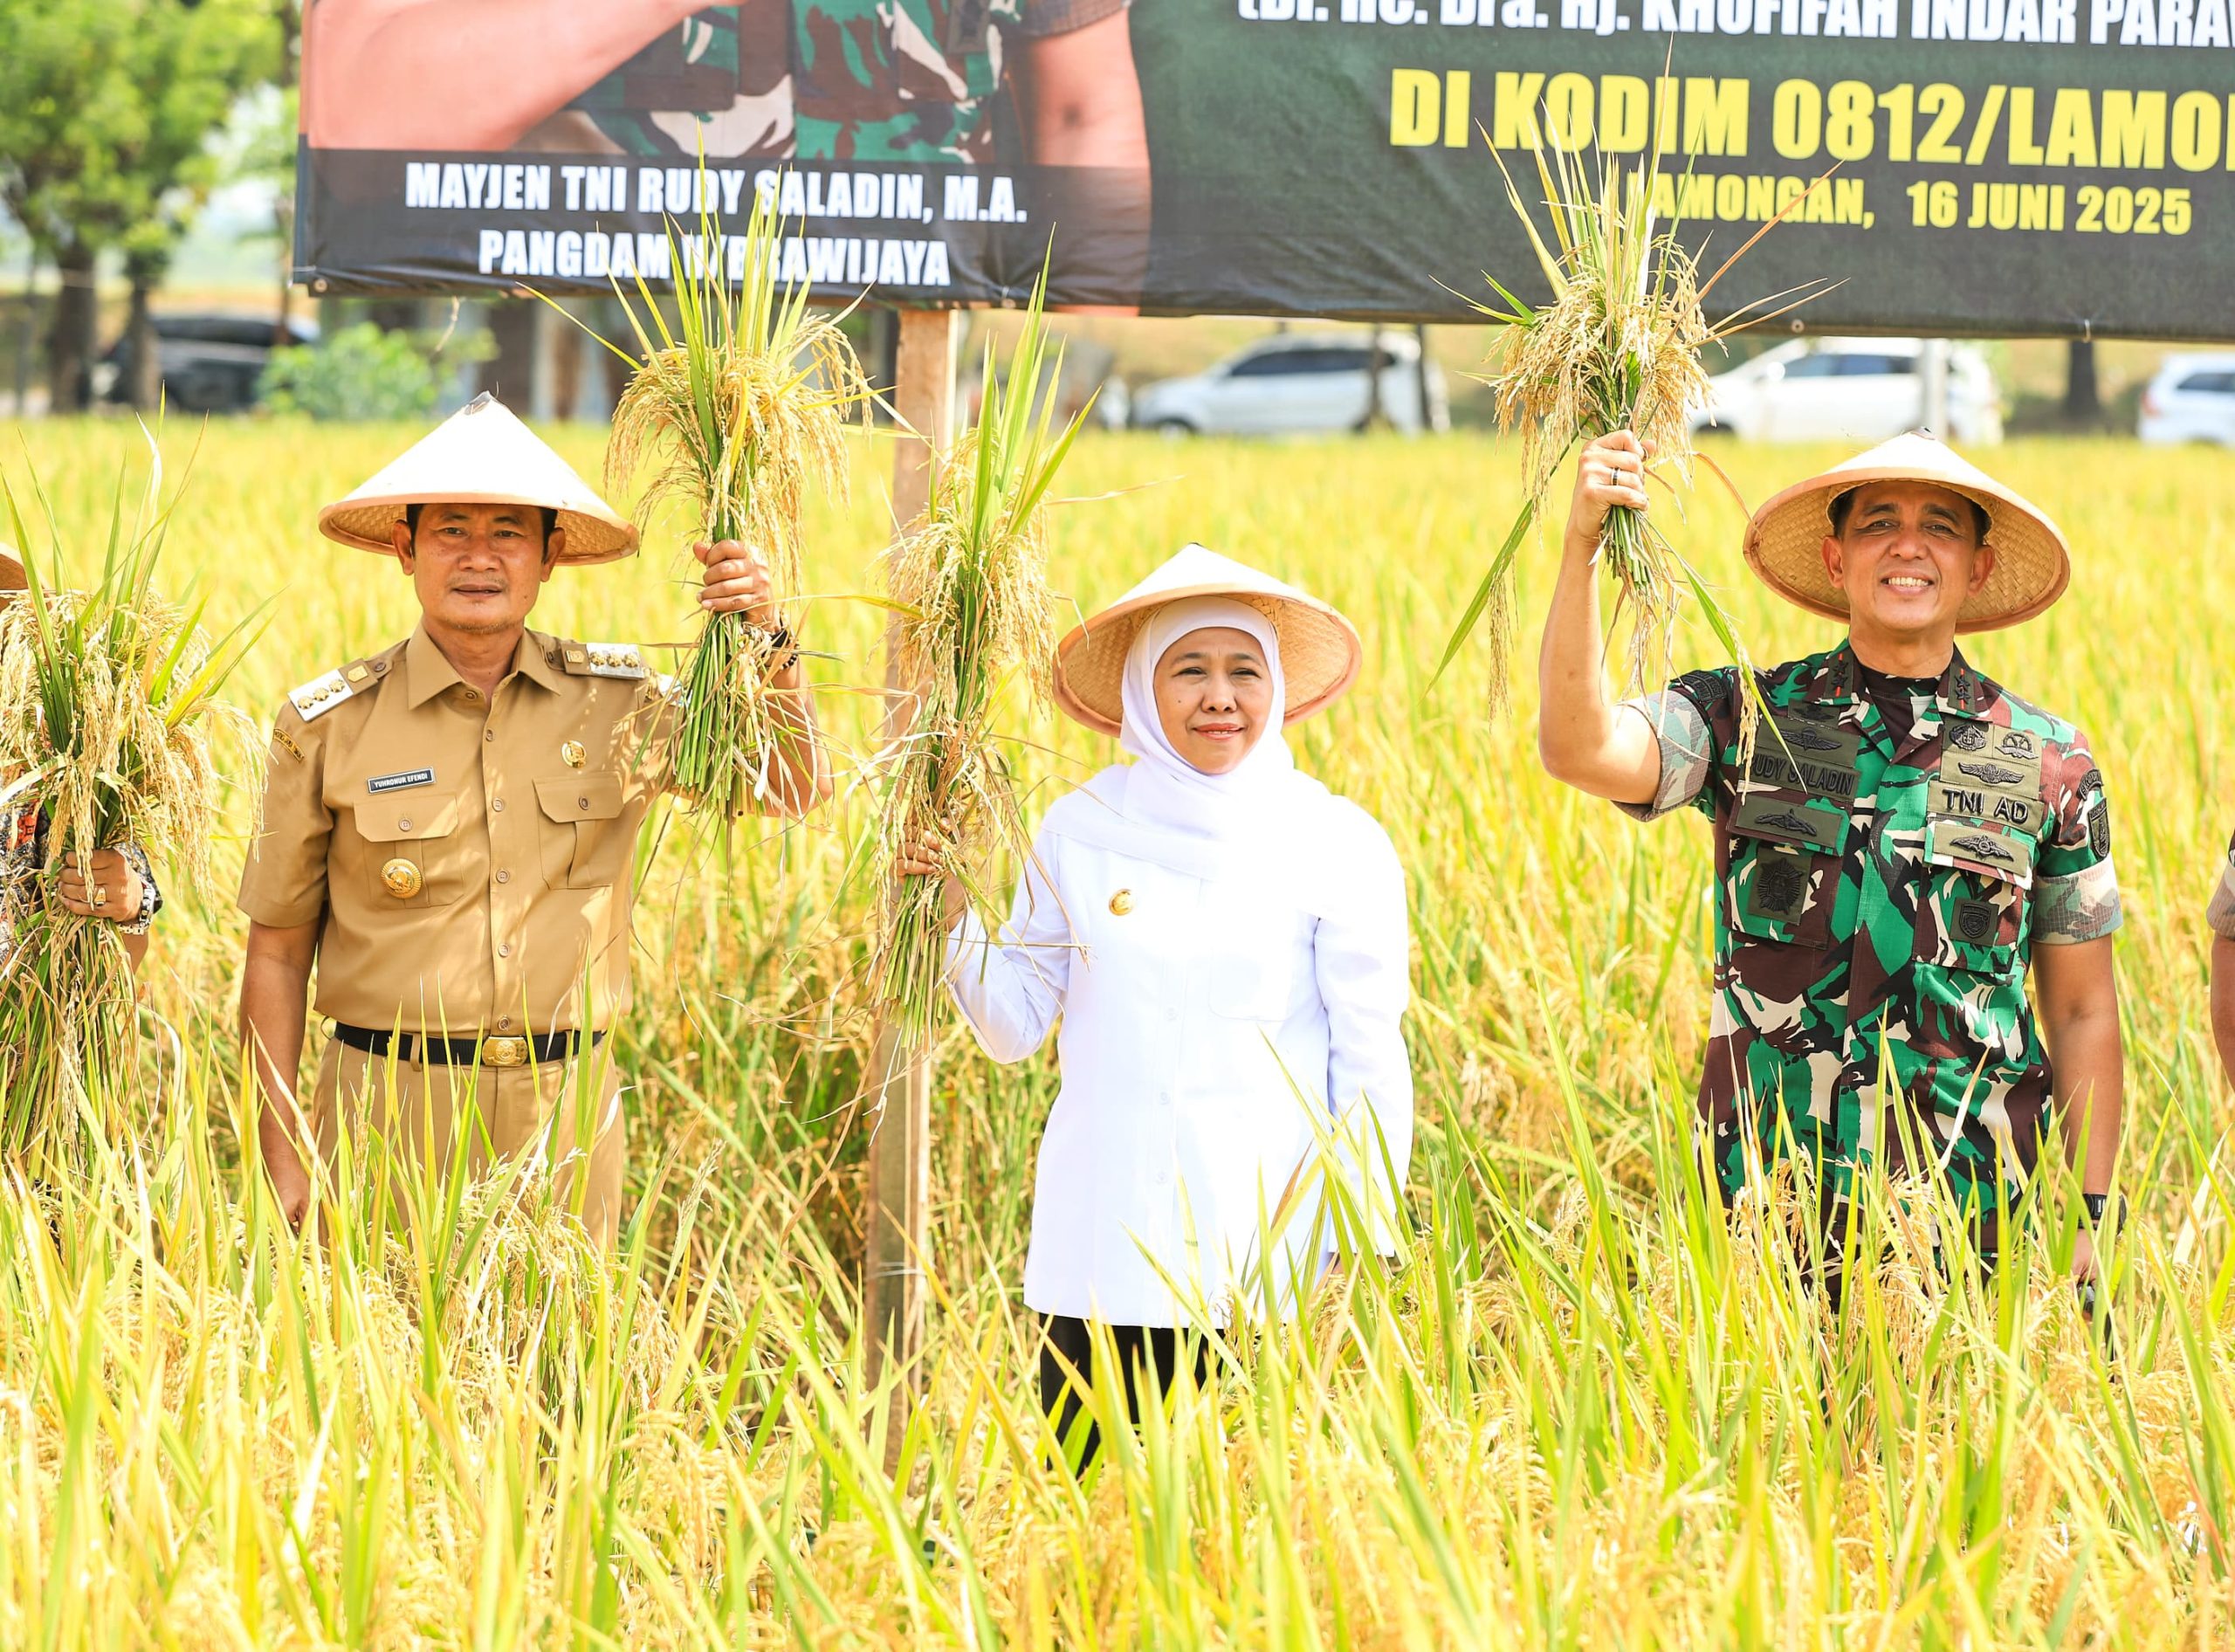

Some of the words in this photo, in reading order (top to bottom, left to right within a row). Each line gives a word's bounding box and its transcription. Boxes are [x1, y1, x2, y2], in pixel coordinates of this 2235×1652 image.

[1642, 0, 1898, 38] KHOFIFAH
[1911, 0, 2077, 44] INDAR
[2090, 0, 2235, 47] PARA
[1390, 68, 1471, 148] DI
[1494, 72, 1750, 156] KODIM
[1772, 79, 2235, 172] 0812/LAMO
[405, 162, 551, 210] MAYJEN
[560, 166, 628, 212] TNI
[638, 167, 746, 215] RUDY
[753, 169, 933, 224] SALADIN,
[944, 176, 1028, 224] M.A.
[1907, 180, 1959, 229] 16
[1968, 182, 2066, 231] JUNI
[2075, 186, 2192, 236] 2025
[478, 229, 671, 279] PANGDAM
[1787, 761, 1855, 796] SALADIN
[1943, 788, 1984, 816] TNI
[1993, 795, 2028, 824] AD
